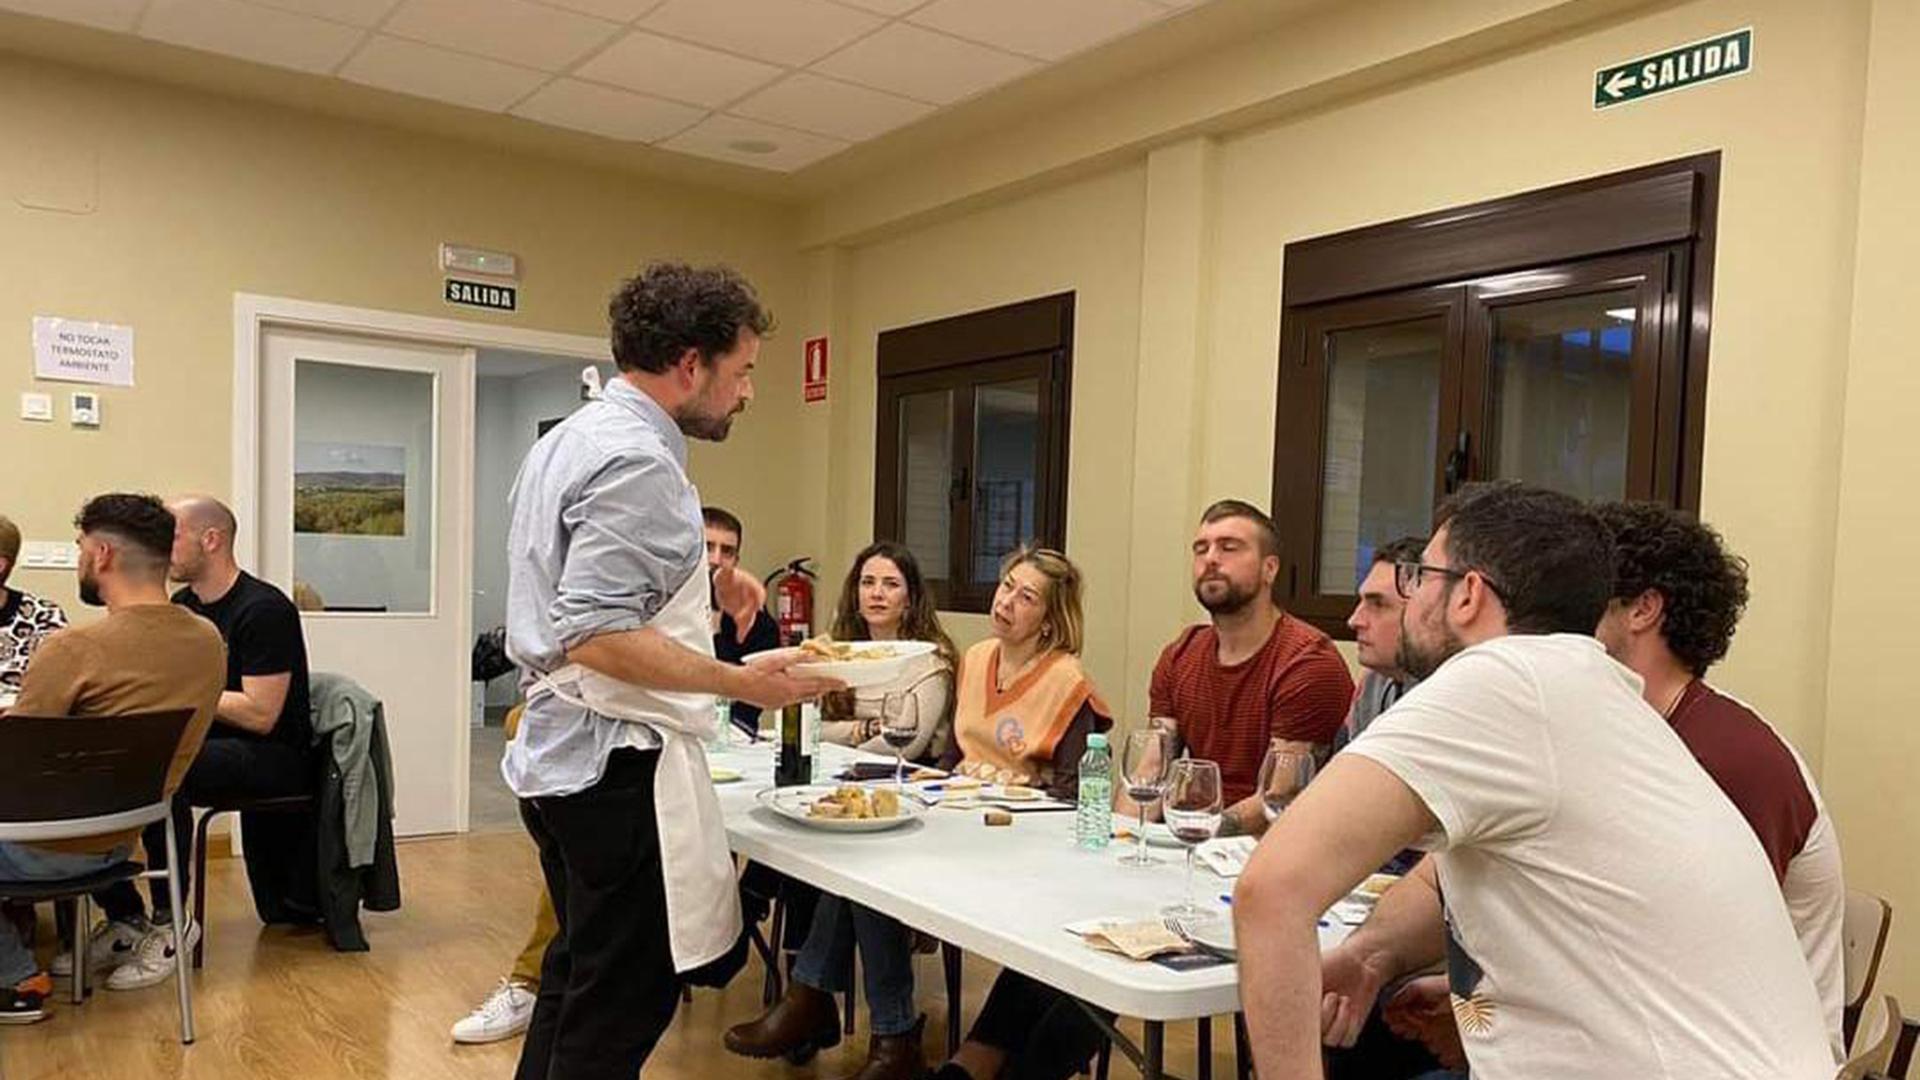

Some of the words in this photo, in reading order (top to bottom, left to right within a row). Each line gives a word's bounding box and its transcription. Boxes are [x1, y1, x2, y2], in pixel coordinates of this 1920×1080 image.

[1642, 39, 1741, 90] SALIDA
[450, 283, 512, 307] SALIDA
[59, 332, 75, 342] NO
[78, 334, 111, 346] TOCAR
[51, 345, 119, 360] TERMOSTATO
[59, 360, 109, 372] AMBIENTE
